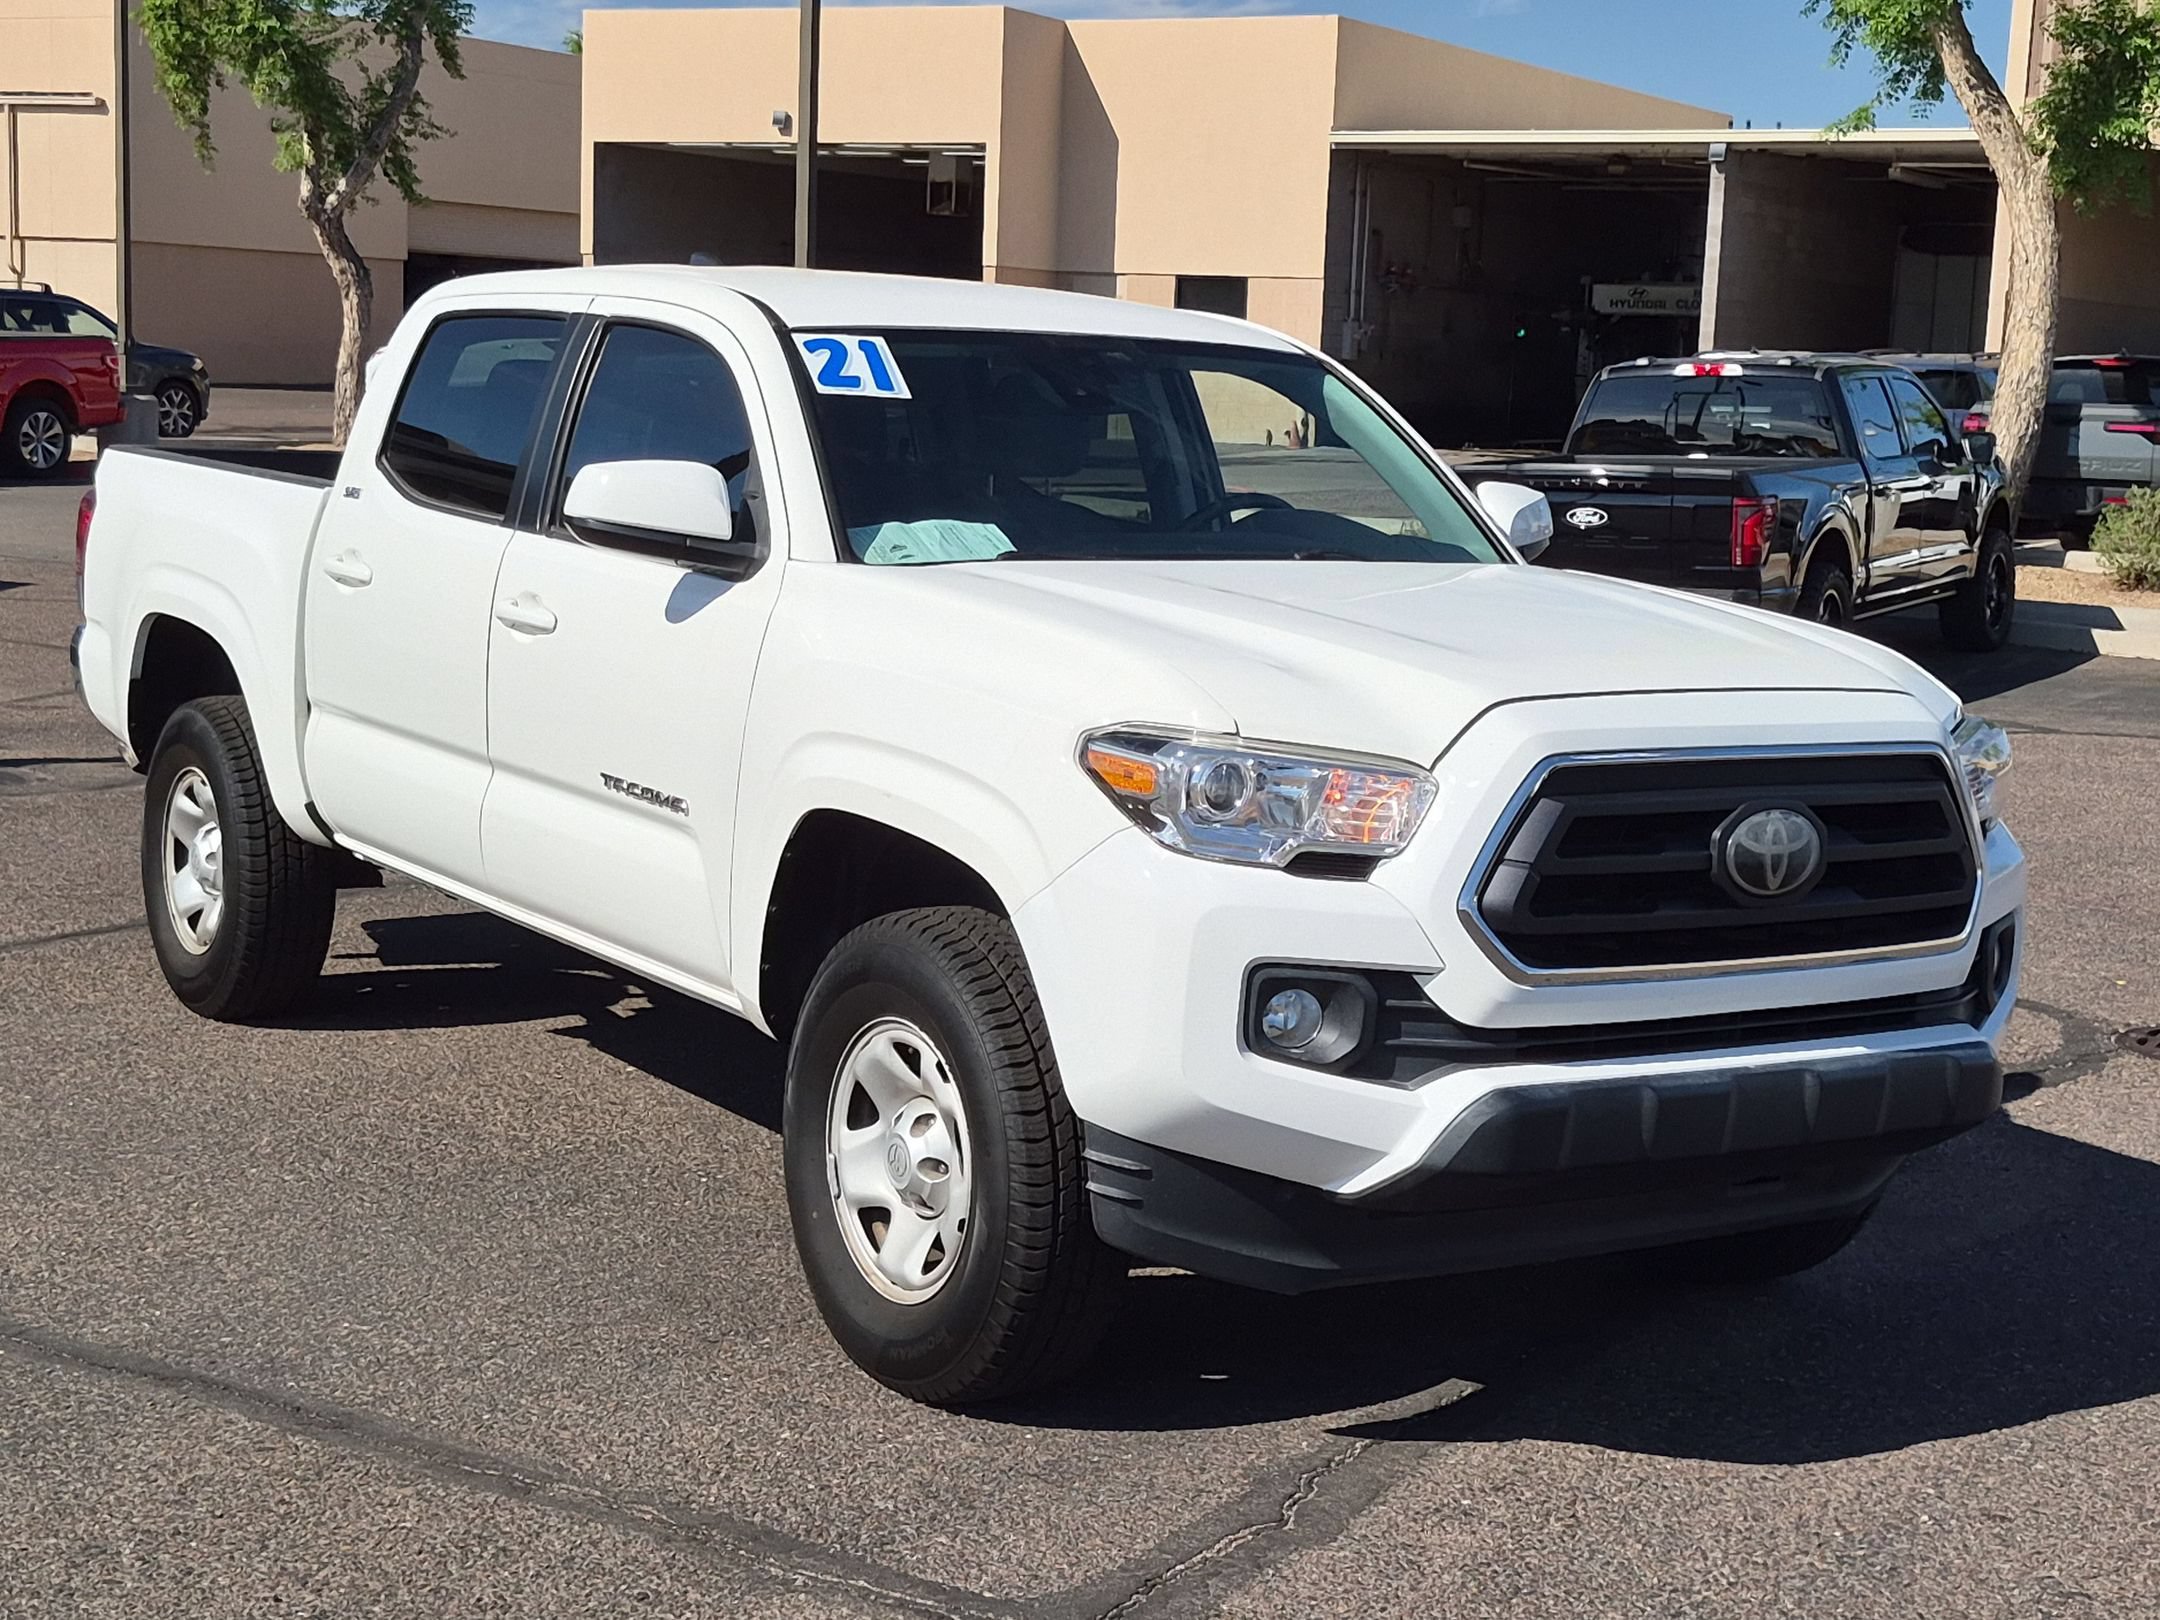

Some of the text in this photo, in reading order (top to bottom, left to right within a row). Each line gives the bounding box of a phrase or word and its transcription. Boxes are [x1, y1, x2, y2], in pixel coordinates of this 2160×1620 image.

[1609, 298, 1667, 310] HYUNDAI
[802, 338, 896, 392] 21
[600, 772, 690, 817] TACOMA
